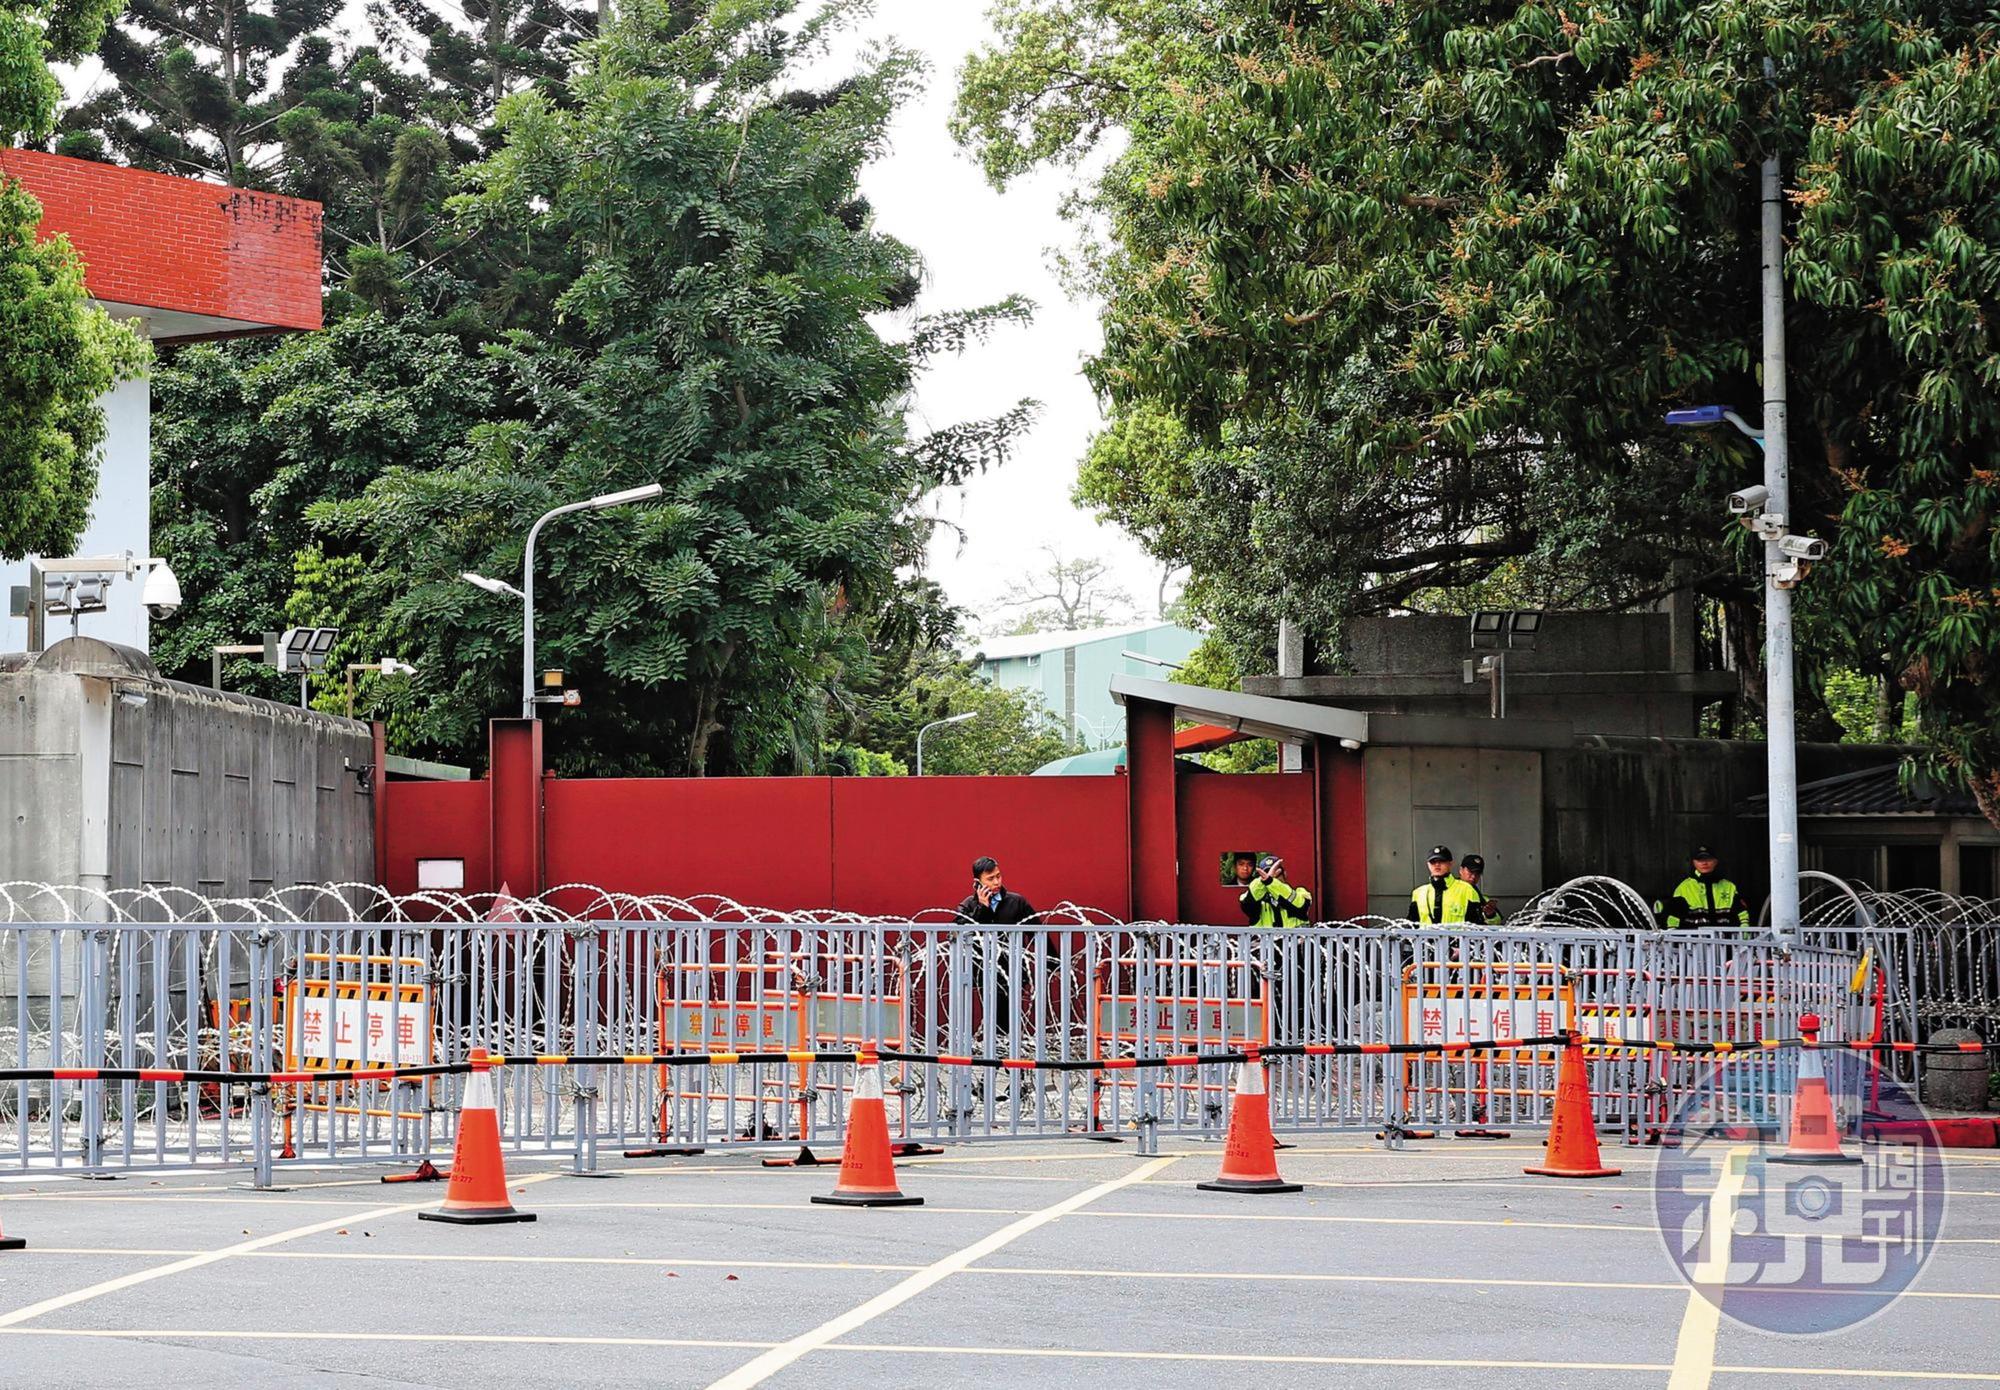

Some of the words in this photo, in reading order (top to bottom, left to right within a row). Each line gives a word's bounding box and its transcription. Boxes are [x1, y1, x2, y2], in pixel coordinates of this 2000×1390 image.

[304, 1008, 415, 1049] 禁止停車
[1424, 1008, 1555, 1039] 禁止停車
